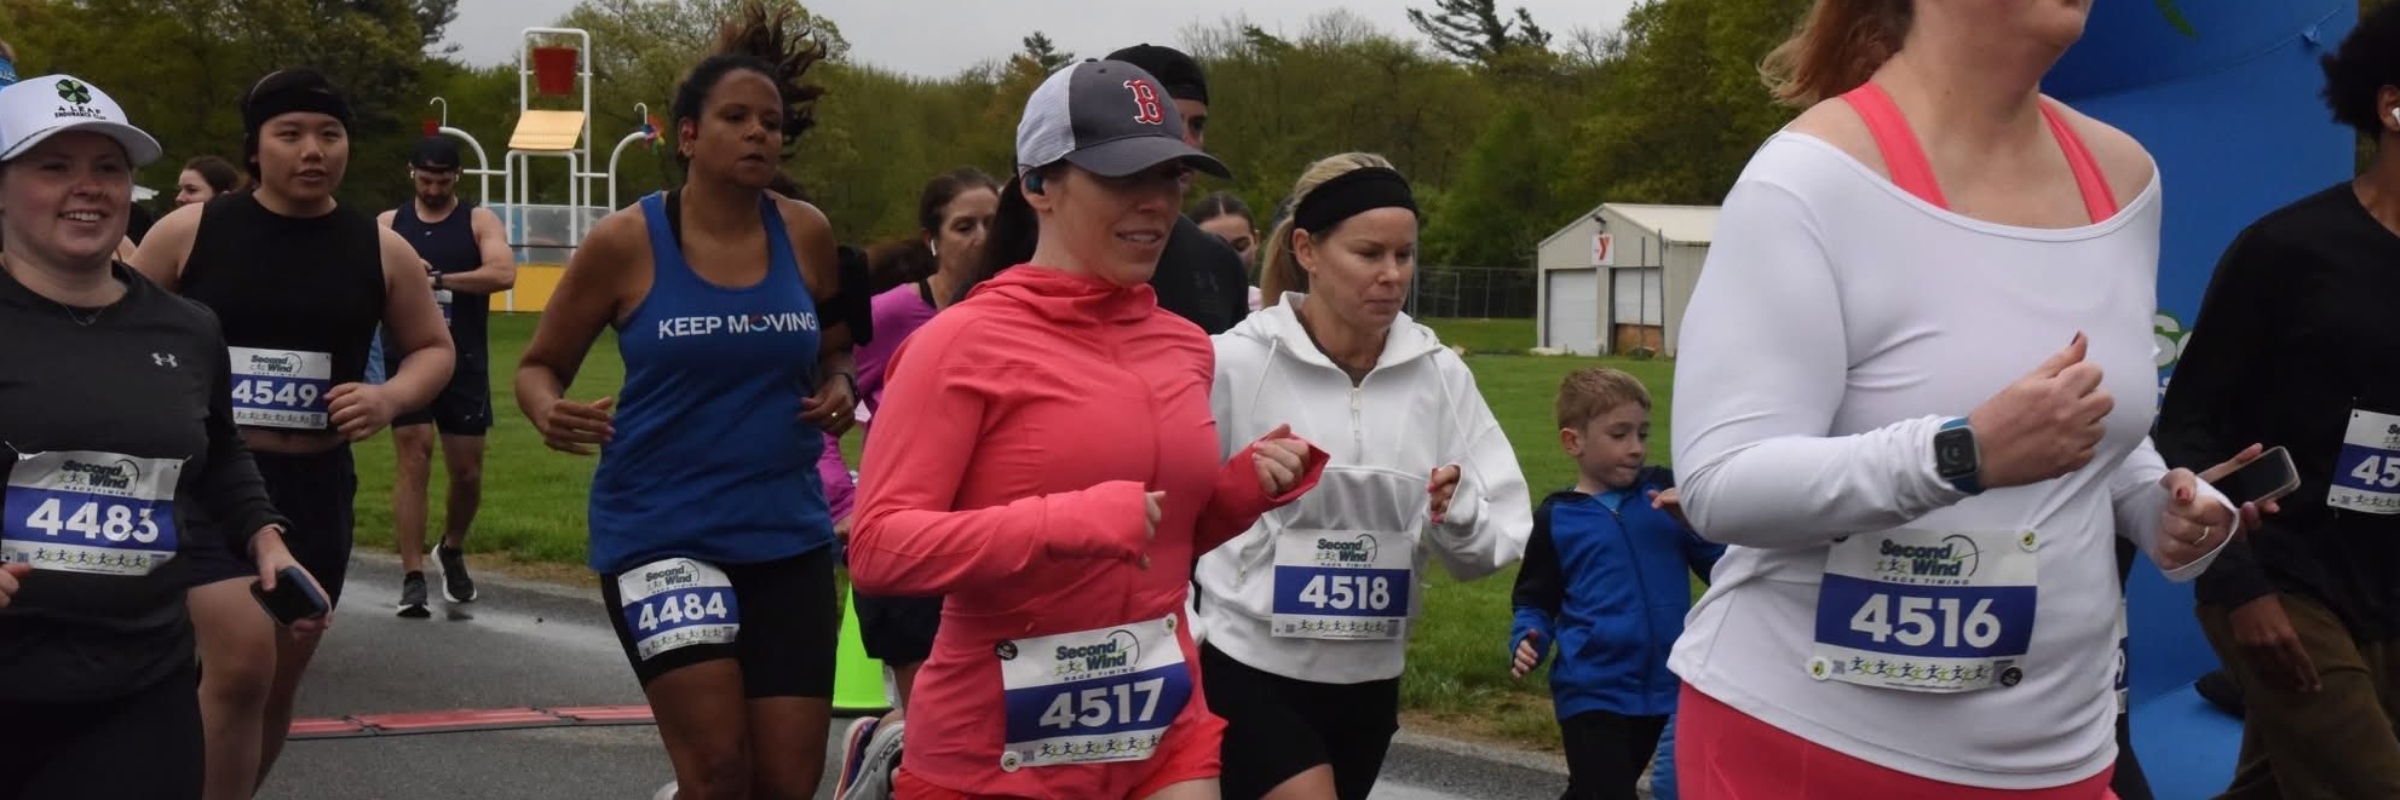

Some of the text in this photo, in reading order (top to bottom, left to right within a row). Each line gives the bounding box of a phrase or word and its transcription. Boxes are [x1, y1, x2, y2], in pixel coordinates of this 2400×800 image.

[1123, 80, 1163, 125] B
[658, 311, 817, 339] KEEP MOVING
[250, 354, 289, 364] Second
[268, 363, 293, 373] Wind
[231, 380, 318, 408] 4549
[62, 459, 122, 476] Second
[88, 473, 129, 489] Wind
[26, 498, 159, 543] 4483
[1316, 538, 1362, 550] Second
[1880, 539, 1952, 560] Second
[1339, 550, 1368, 562] Wind
[646, 565, 684, 582] Second
[1912, 559, 1962, 576] Wind
[665, 574, 692, 584] Wind
[1298, 574, 1390, 610] 4518
[638, 592, 727, 631] 4484
[1850, 593, 2001, 648] 4516
[1055, 639, 1117, 661] Second
[1086, 651, 1127, 671] Wind
[1039, 677, 1164, 729] 4517
